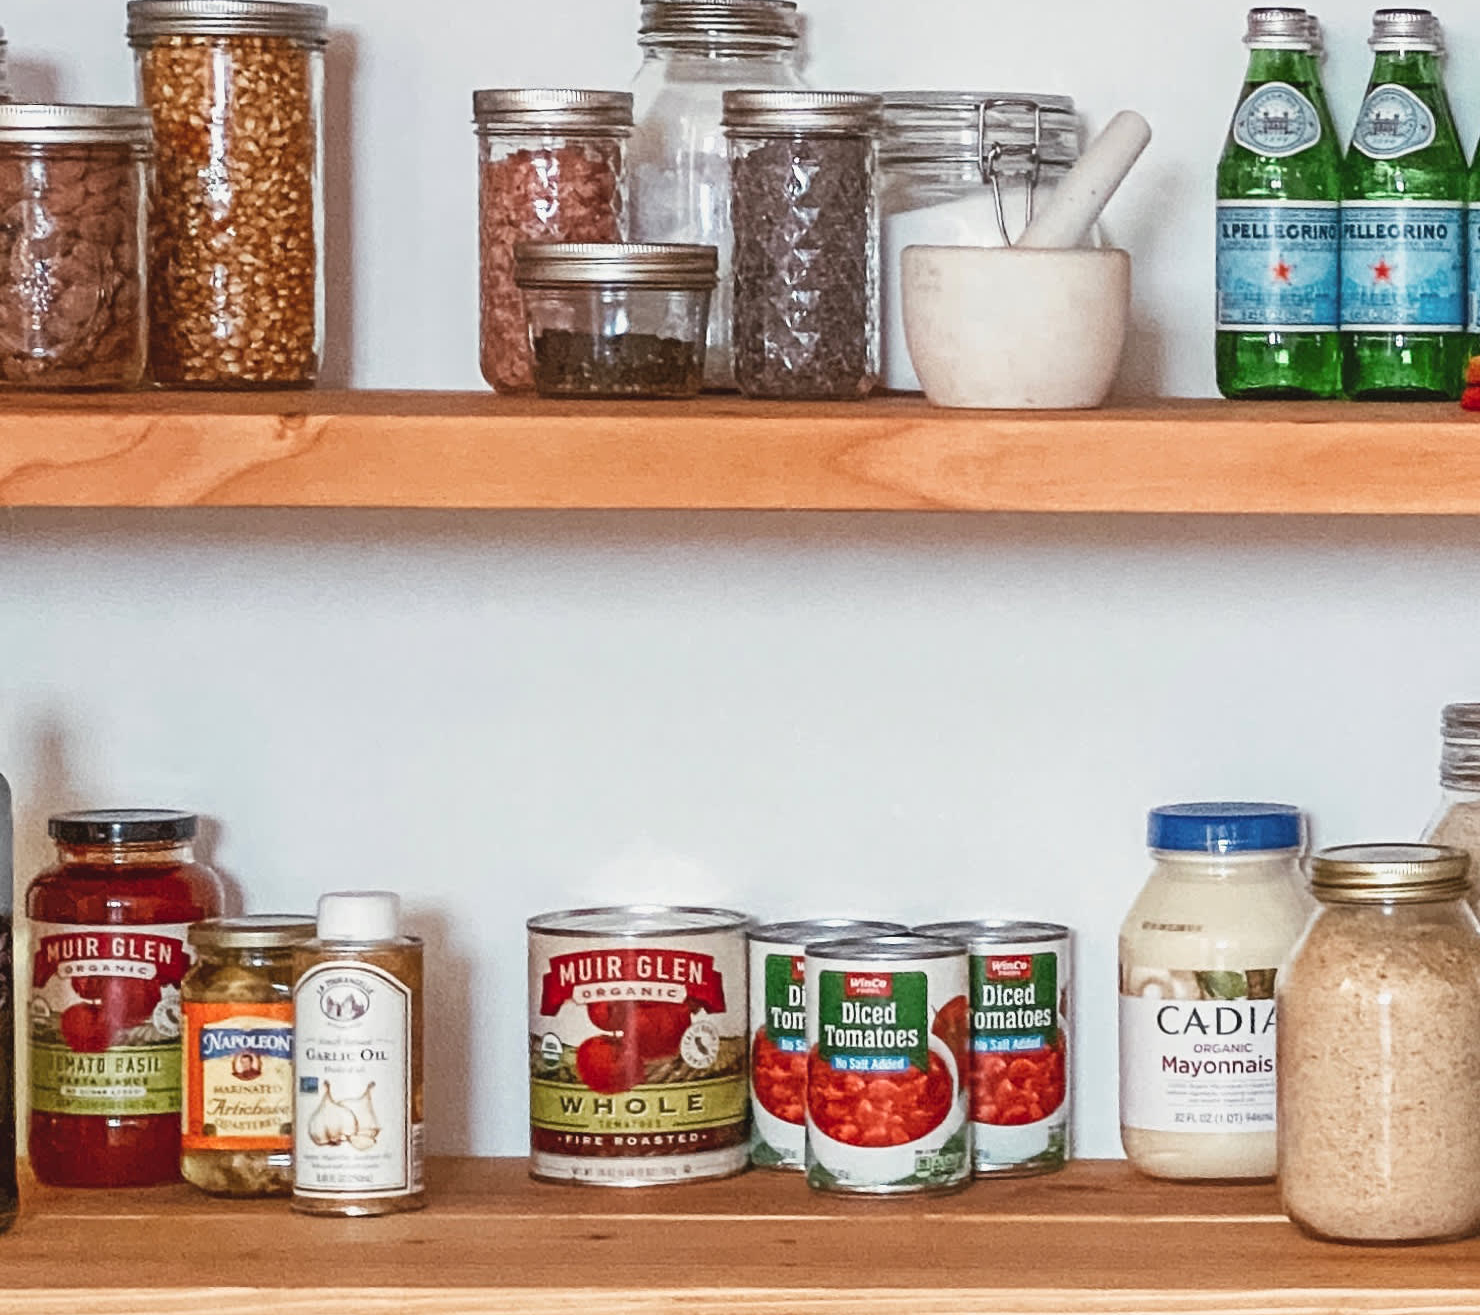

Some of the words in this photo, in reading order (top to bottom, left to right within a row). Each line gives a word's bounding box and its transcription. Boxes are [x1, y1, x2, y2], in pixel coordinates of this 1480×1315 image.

[46, 937, 99, 964] MUIR
[111, 936, 172, 965] GLEN
[63, 963, 150, 976] ORGANIC
[559, 955, 623, 987] MUIR
[636, 955, 703, 985] GLEN
[991, 960, 1028, 971] WinCo
[850, 977, 888, 988] WinCo
[581, 987, 678, 999] ORGANIC
[982, 983, 1036, 1006] Diced
[841, 1001, 897, 1025] Diced
[970, 1008, 1052, 1030] omatoes
[203, 1030, 291, 1055] NAPOLEON
[824, 1024, 919, 1049] Tomatoes
[989, 1038, 1010, 1050] Salt
[1012, 1037, 1042, 1050] Added
[306, 1047, 354, 1061] GARLIC
[360, 1048, 389, 1061] OIL
[1193, 1043, 1254, 1054] ORGANIC
[115, 1056, 162, 1074] BASIL
[849, 1057, 869, 1070] Salt
[870, 1056, 905, 1070] Added
[559, 1093, 704, 1115] WHOLE
[565, 1135, 604, 1146] FIRE
[613, 1133, 698, 1146] ROASTED
